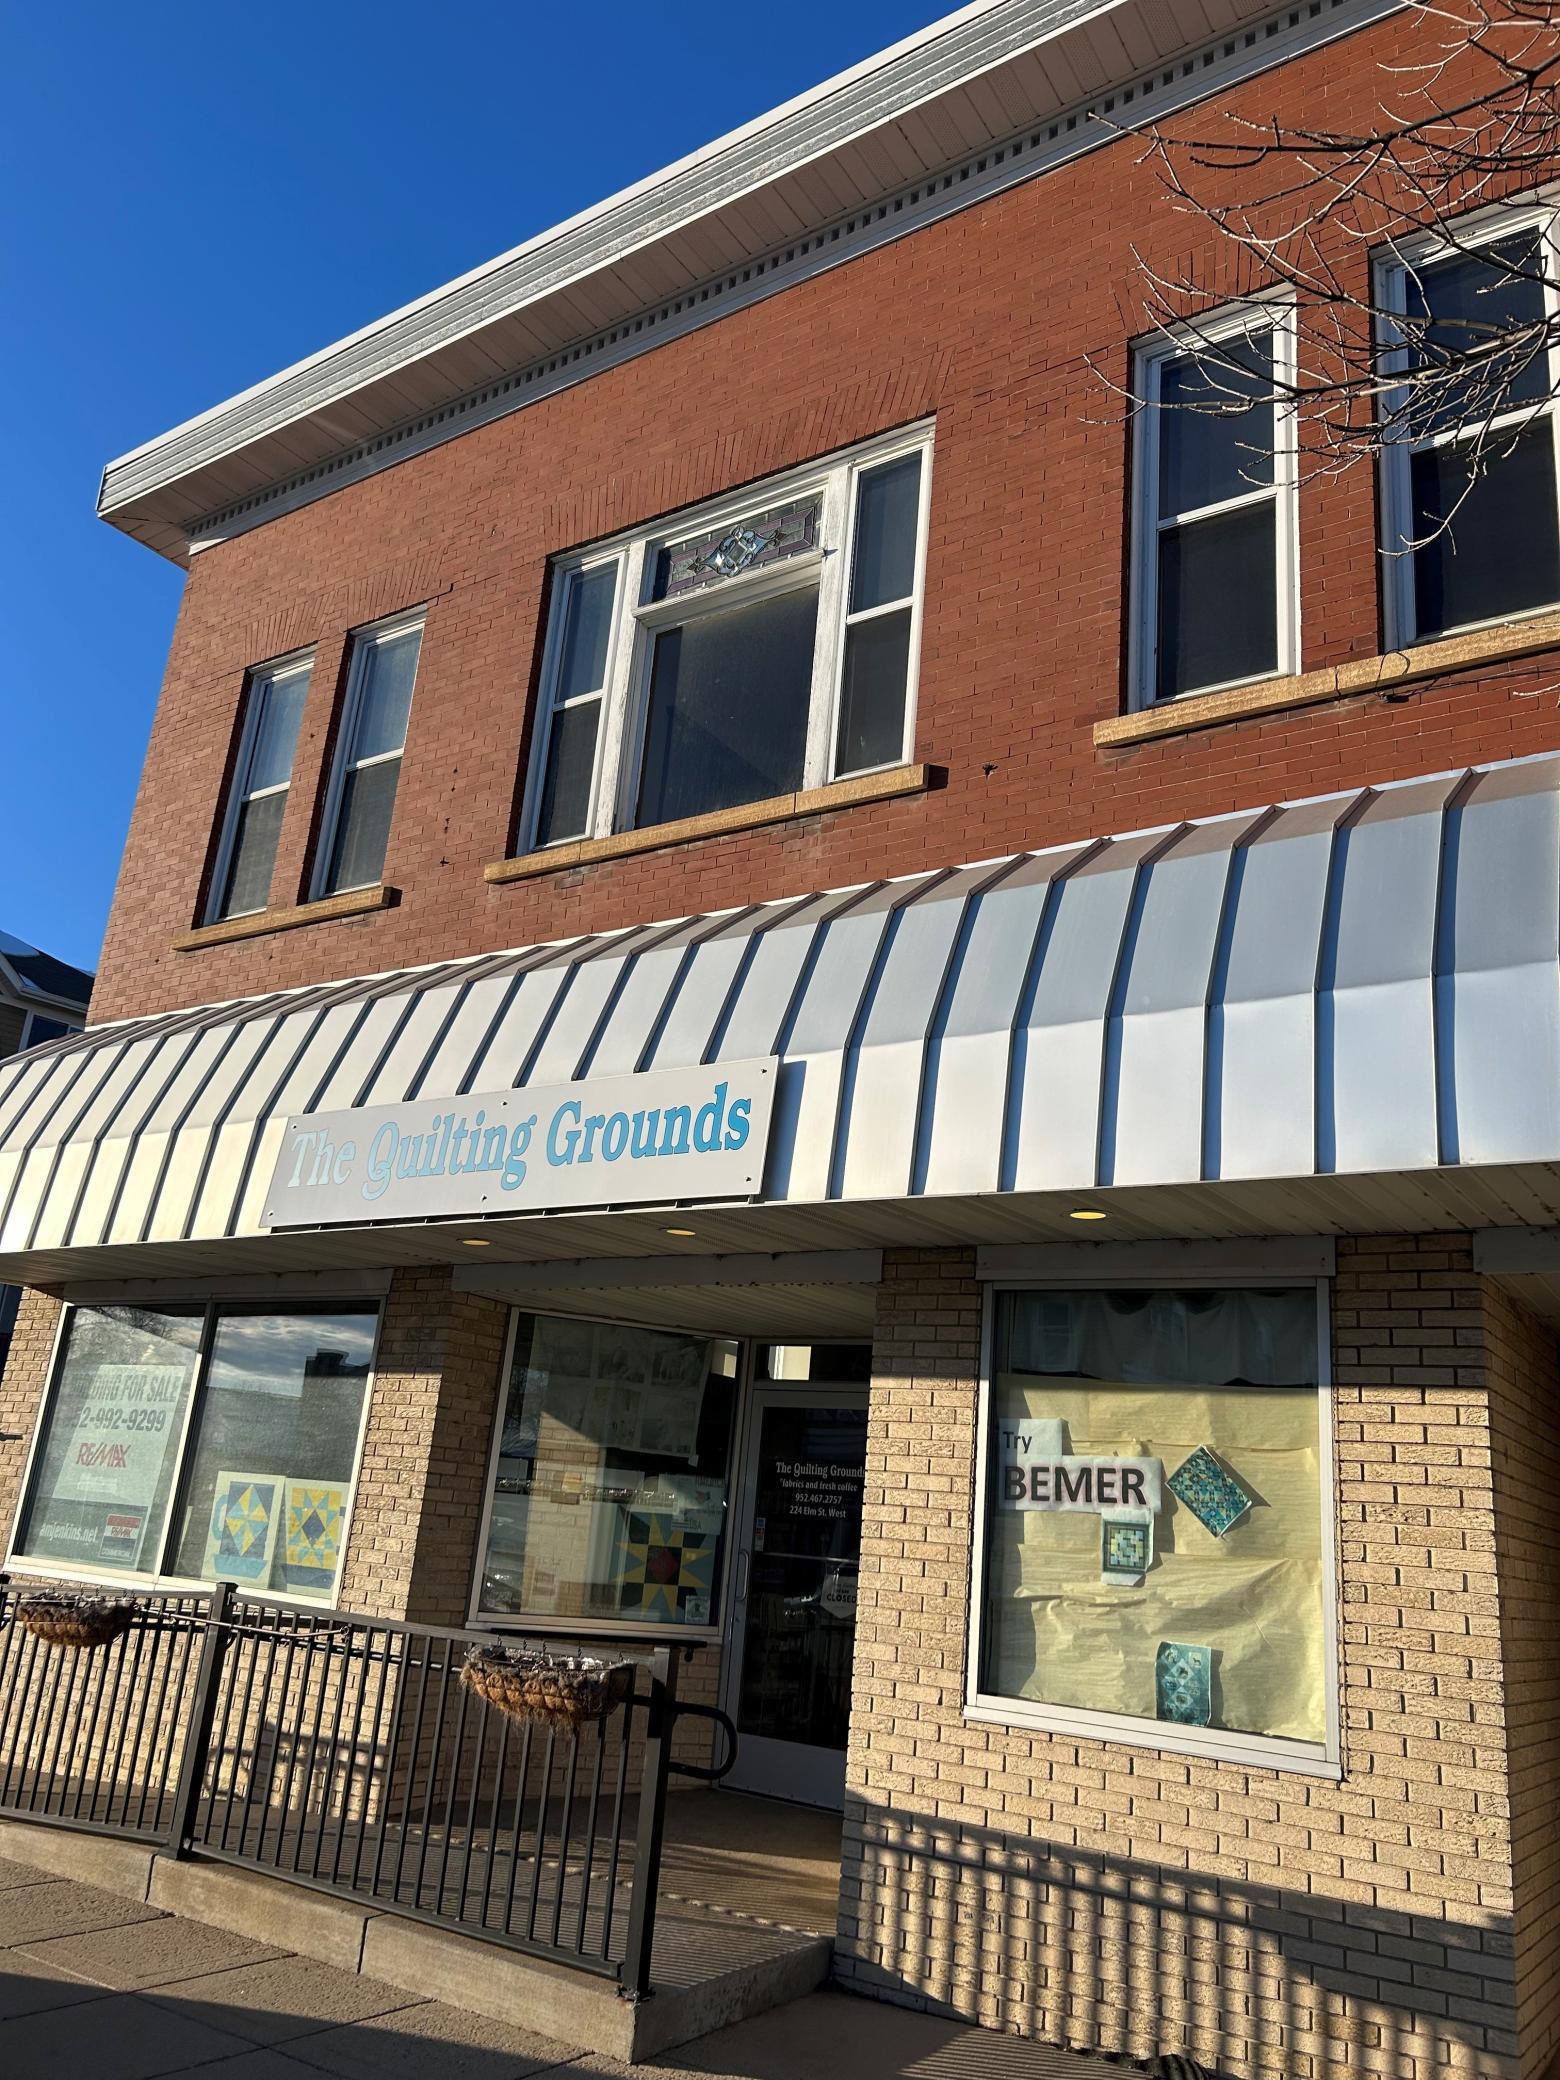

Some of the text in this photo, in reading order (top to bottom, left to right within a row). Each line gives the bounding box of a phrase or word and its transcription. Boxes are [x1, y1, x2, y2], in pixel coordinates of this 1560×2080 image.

[287, 1081, 752, 1201] The Quilting Grounds
[121, 1375, 147, 1401] FOR
[148, 1376, 180, 1402] SALE
[1003, 1431, 1033, 1453] Try
[76, 1442, 131, 1468] RE/MAX
[776, 1462, 792, 1474] The
[794, 1463, 828, 1478] Quilting
[805, 1480, 818, 1490] and
[819, 1481, 836, 1491] fresh
[1004, 1465, 1147, 1505] BEMER
[795, 1493, 842, 1504] 952.467.2757
[789, 1505, 847, 1518] 224 Elm St. West
